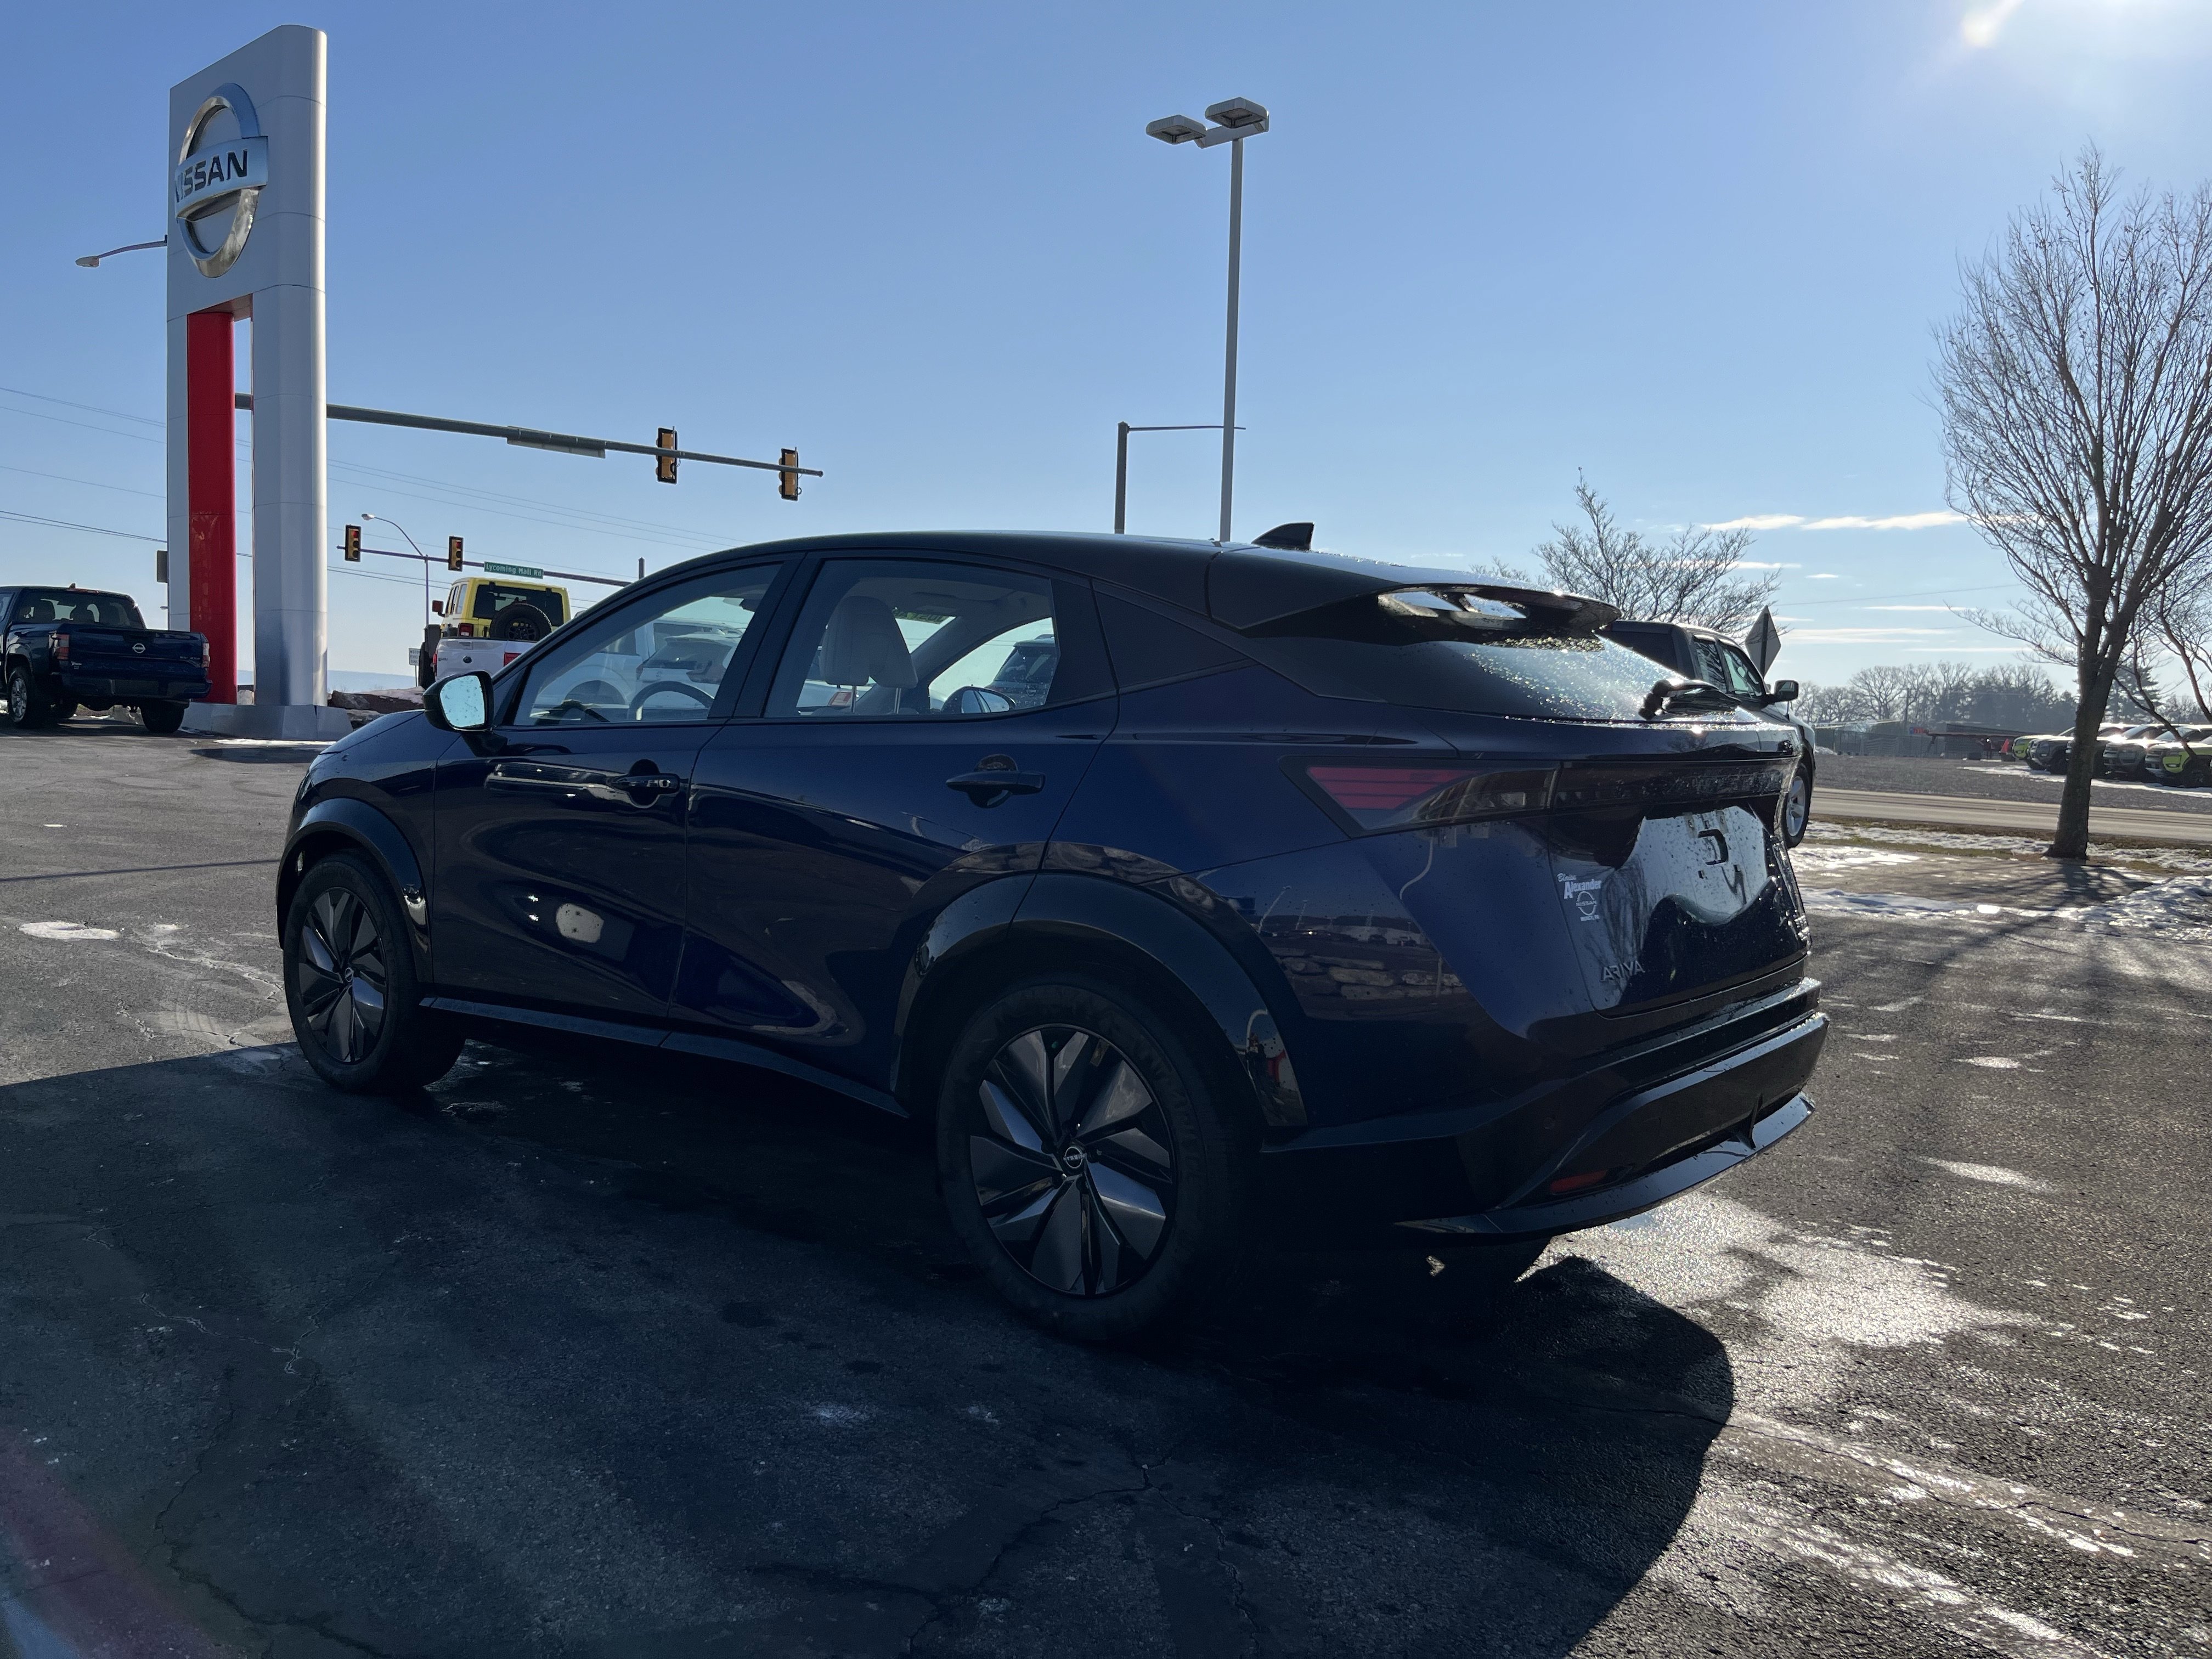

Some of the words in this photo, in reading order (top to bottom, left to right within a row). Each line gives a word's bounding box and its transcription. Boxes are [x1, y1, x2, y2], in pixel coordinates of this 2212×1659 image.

[176, 149, 248, 203] NISSAN
[486, 563, 516, 575] Lycoming
[1564, 879, 1602, 899] Alexander
[1600, 960, 1645, 982] ARIYA
